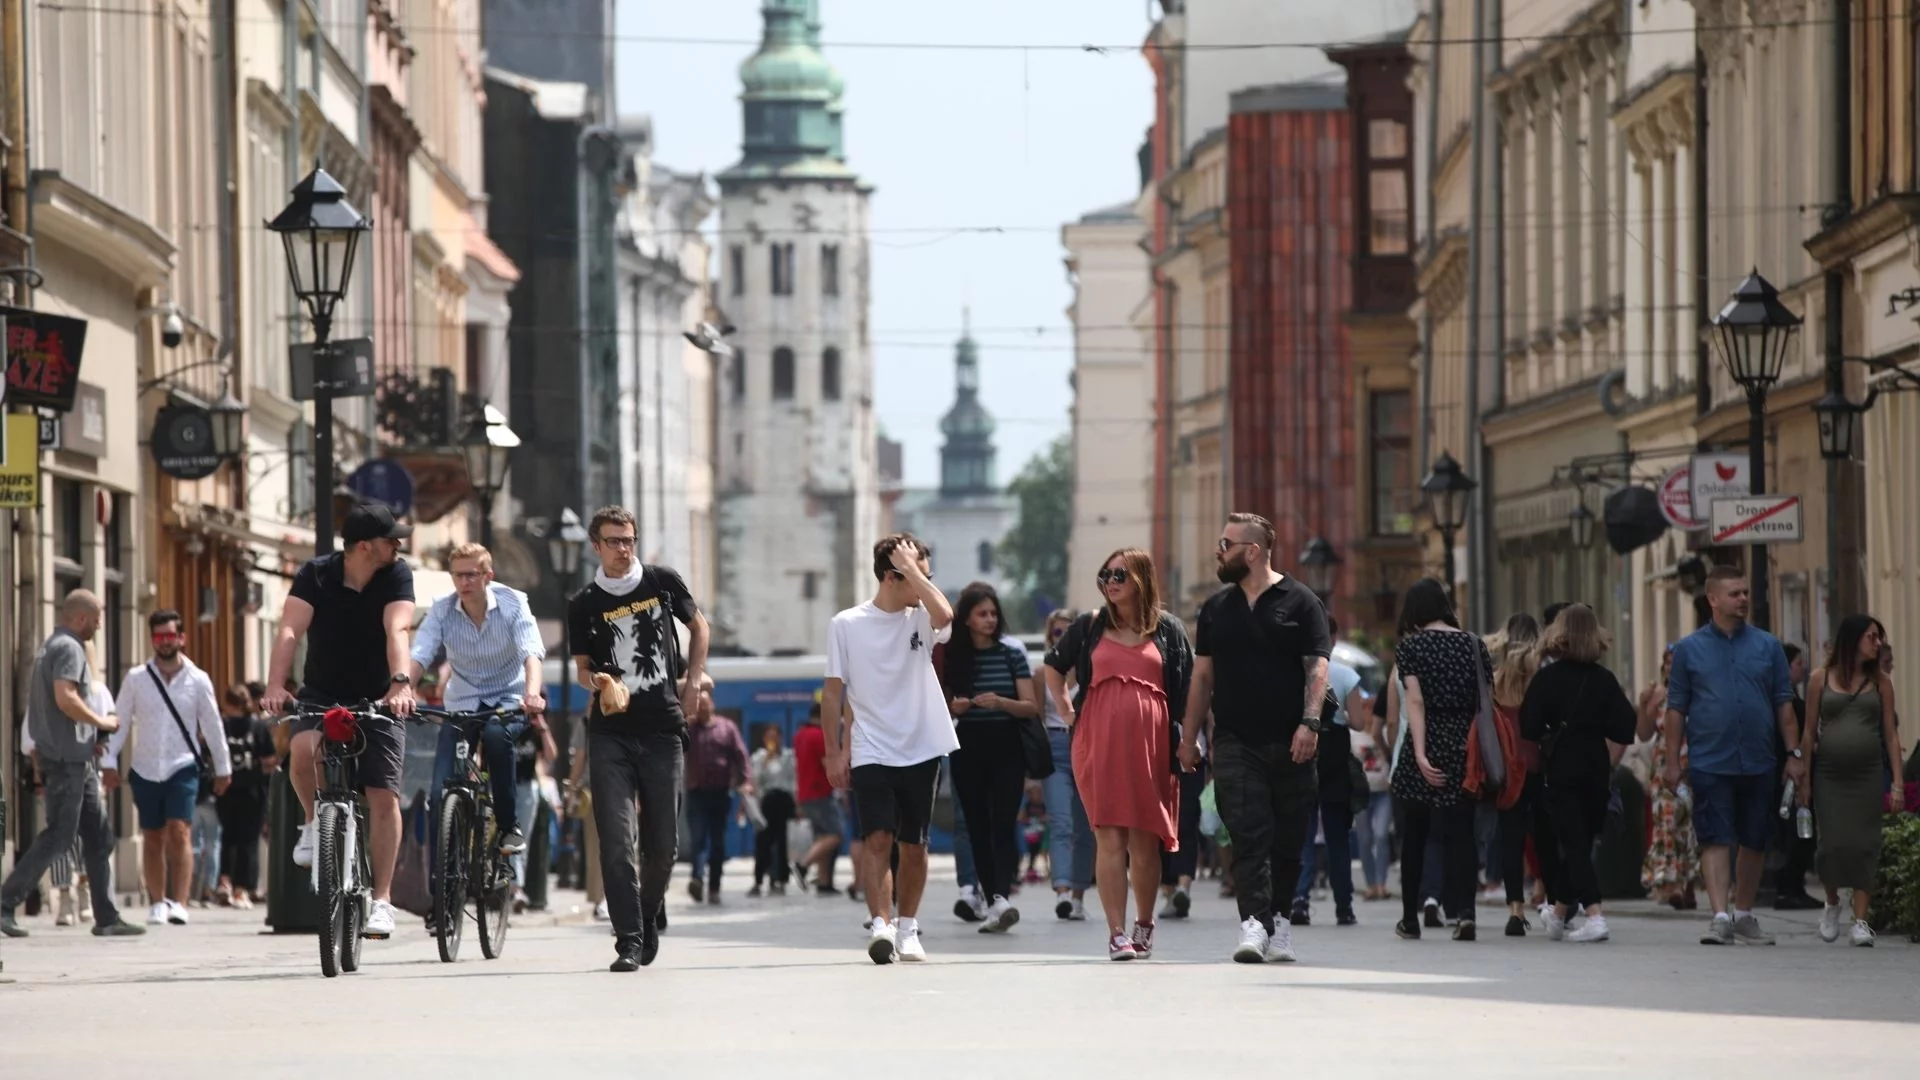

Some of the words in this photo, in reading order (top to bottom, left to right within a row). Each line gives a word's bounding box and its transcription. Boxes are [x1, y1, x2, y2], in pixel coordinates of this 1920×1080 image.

[1736, 504, 1772, 518] Drog
[1719, 521, 1793, 533] wnętrzna
[603, 606, 632, 622] Pacific
[630, 596, 660, 613] Shores
